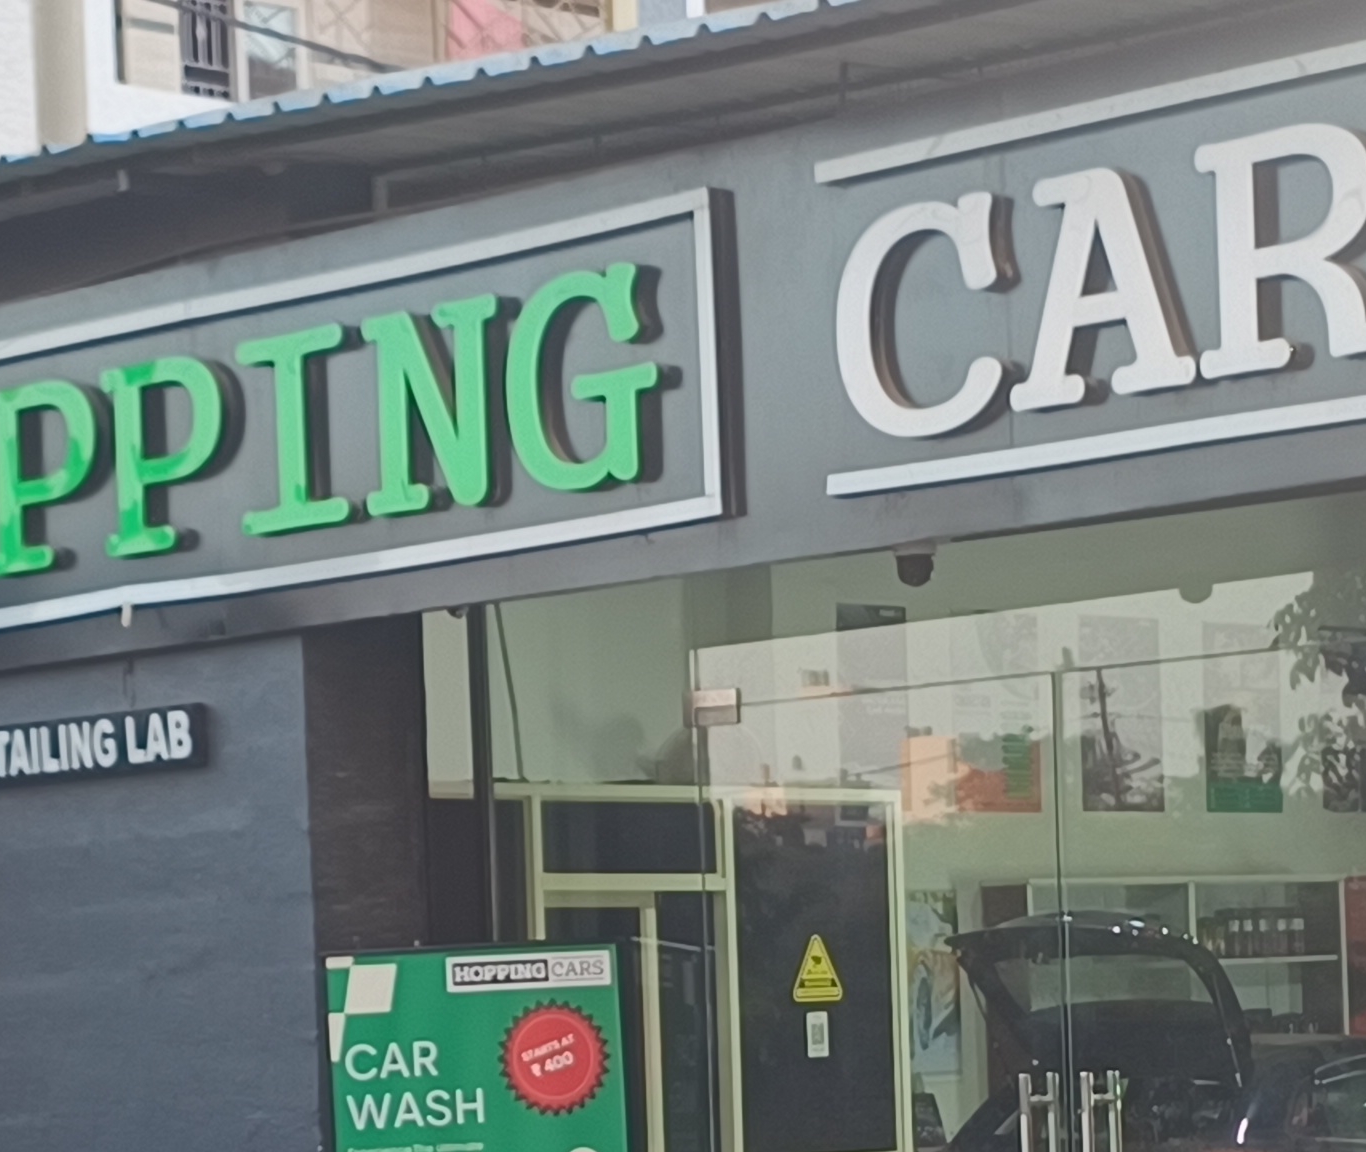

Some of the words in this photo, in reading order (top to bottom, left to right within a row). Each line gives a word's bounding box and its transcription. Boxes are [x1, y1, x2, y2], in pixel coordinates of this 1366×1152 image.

[124, 710, 193, 764] LAB
[453, 962, 547, 983] HOPPING
[551, 959, 605, 978] CARS
[344, 1040, 439, 1081] CAR
[544, 1051, 574, 1071] 400
[346, 1088, 486, 1131] WASH
